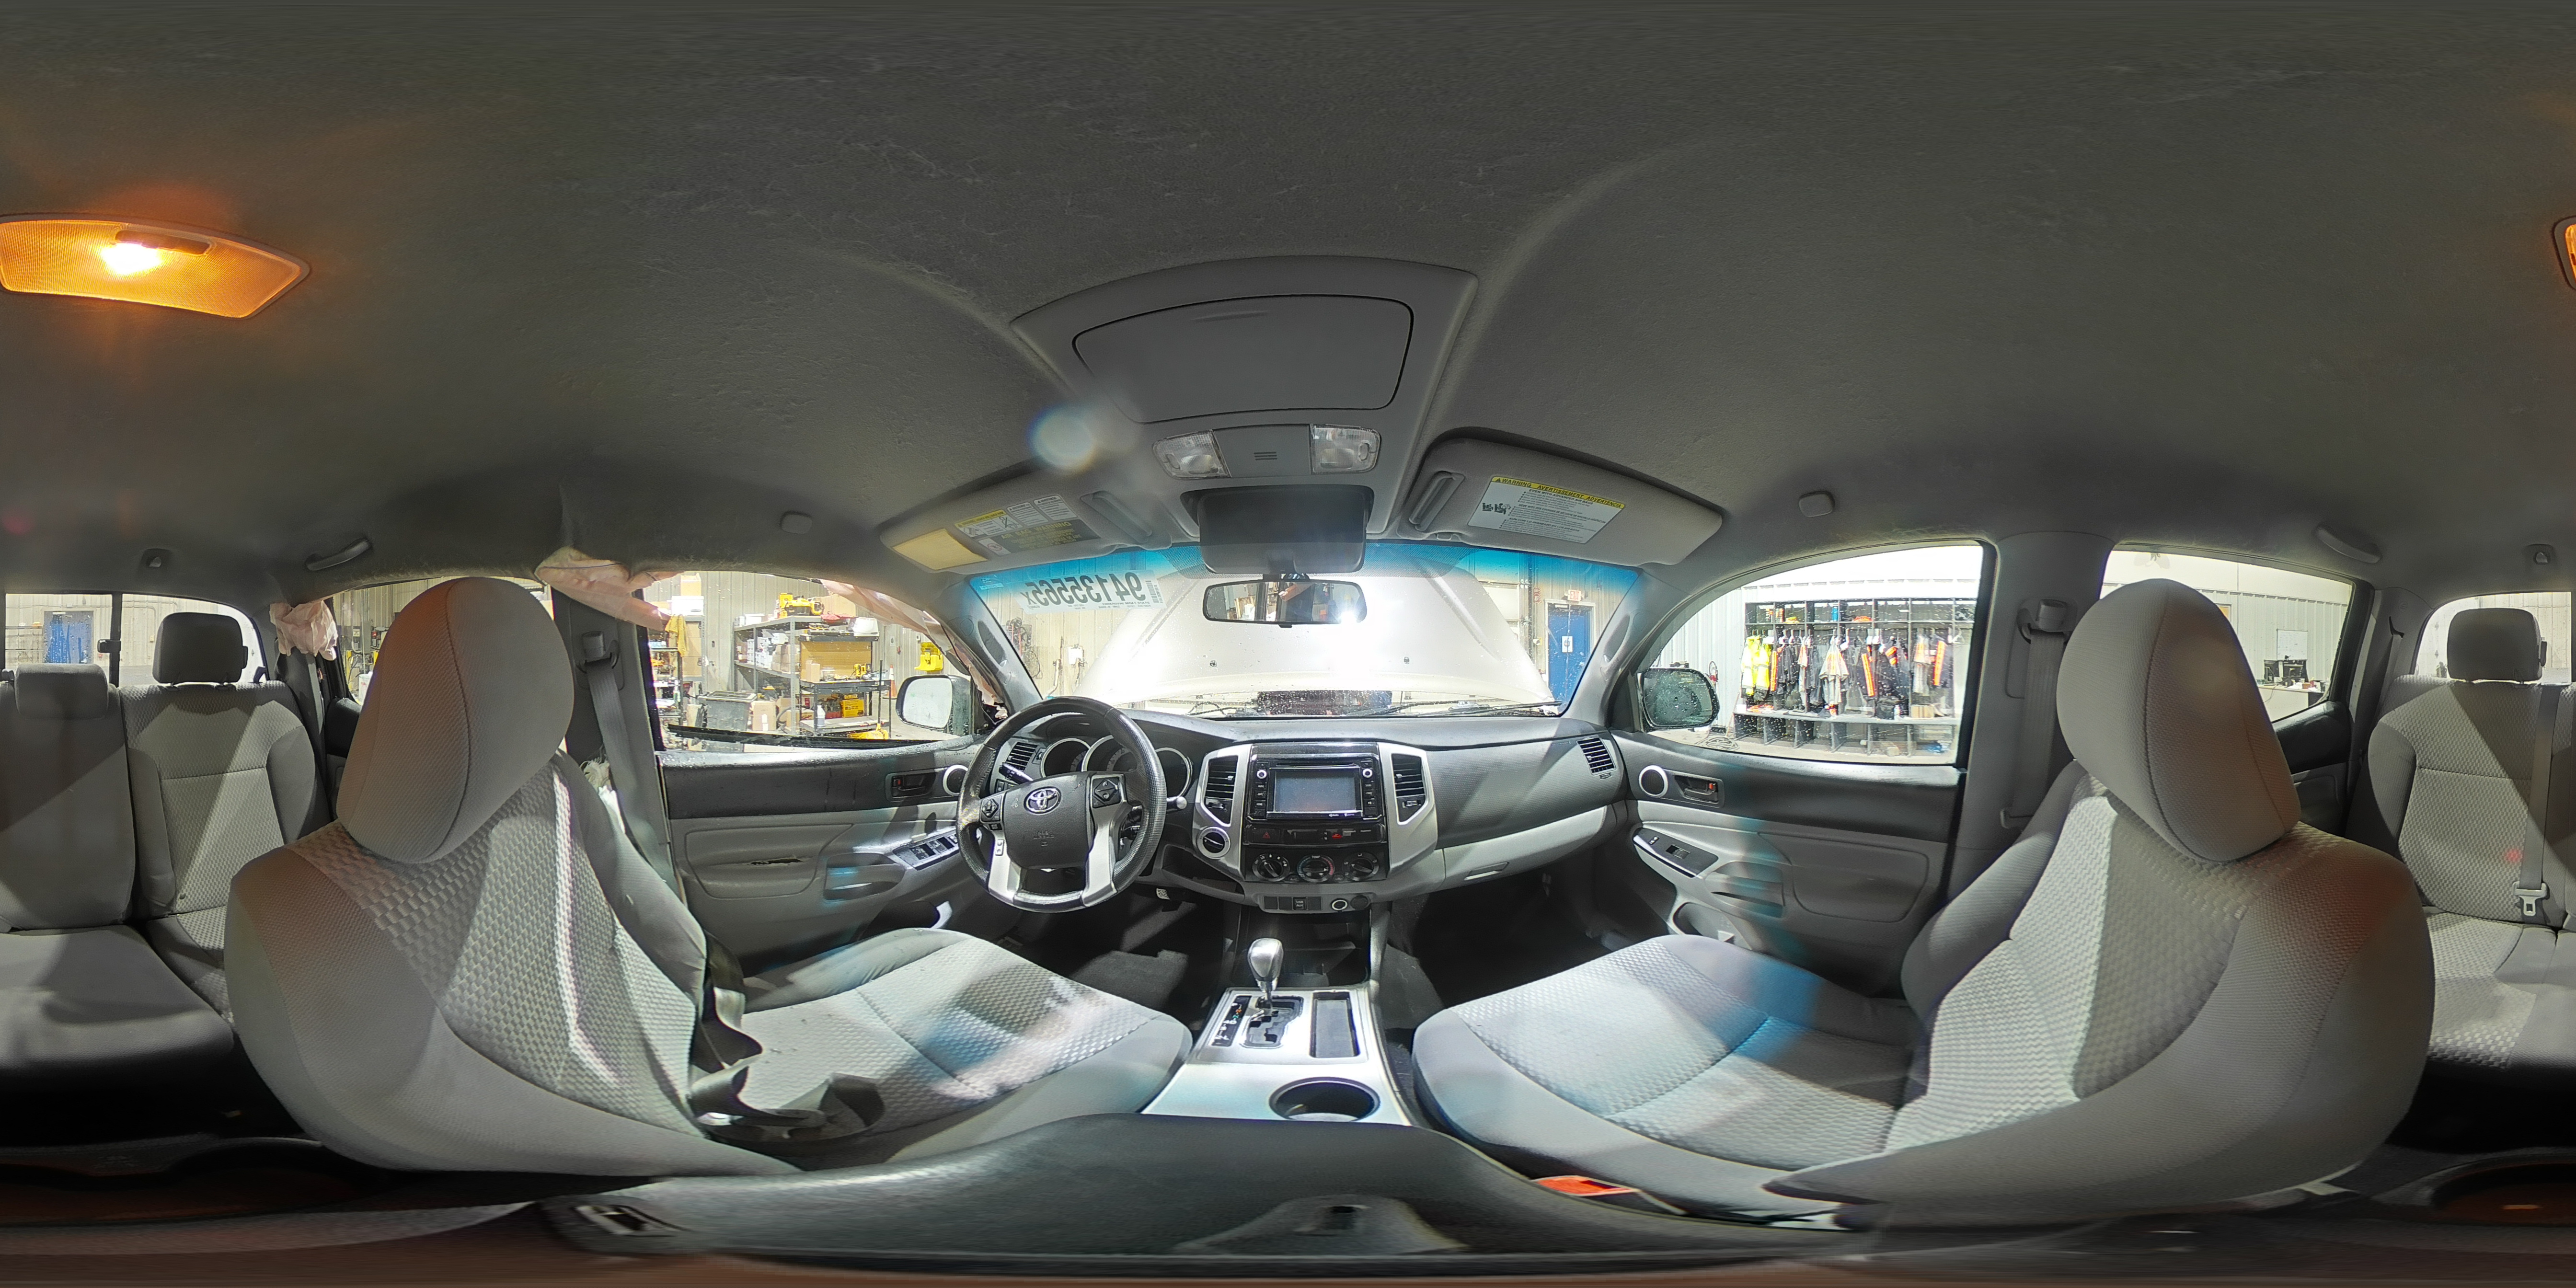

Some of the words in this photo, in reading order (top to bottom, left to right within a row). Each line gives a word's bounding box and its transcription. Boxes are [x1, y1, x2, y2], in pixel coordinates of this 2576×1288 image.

[1502, 479, 1531, 487] WARNING
[1537, 485, 1584, 498] AVERTISSEMENT
[1587, 496, 1622, 508] ADVERTENCIA
[1034, 521, 1072, 531] WARNING
[1570, 590, 1579, 599] EXIT
